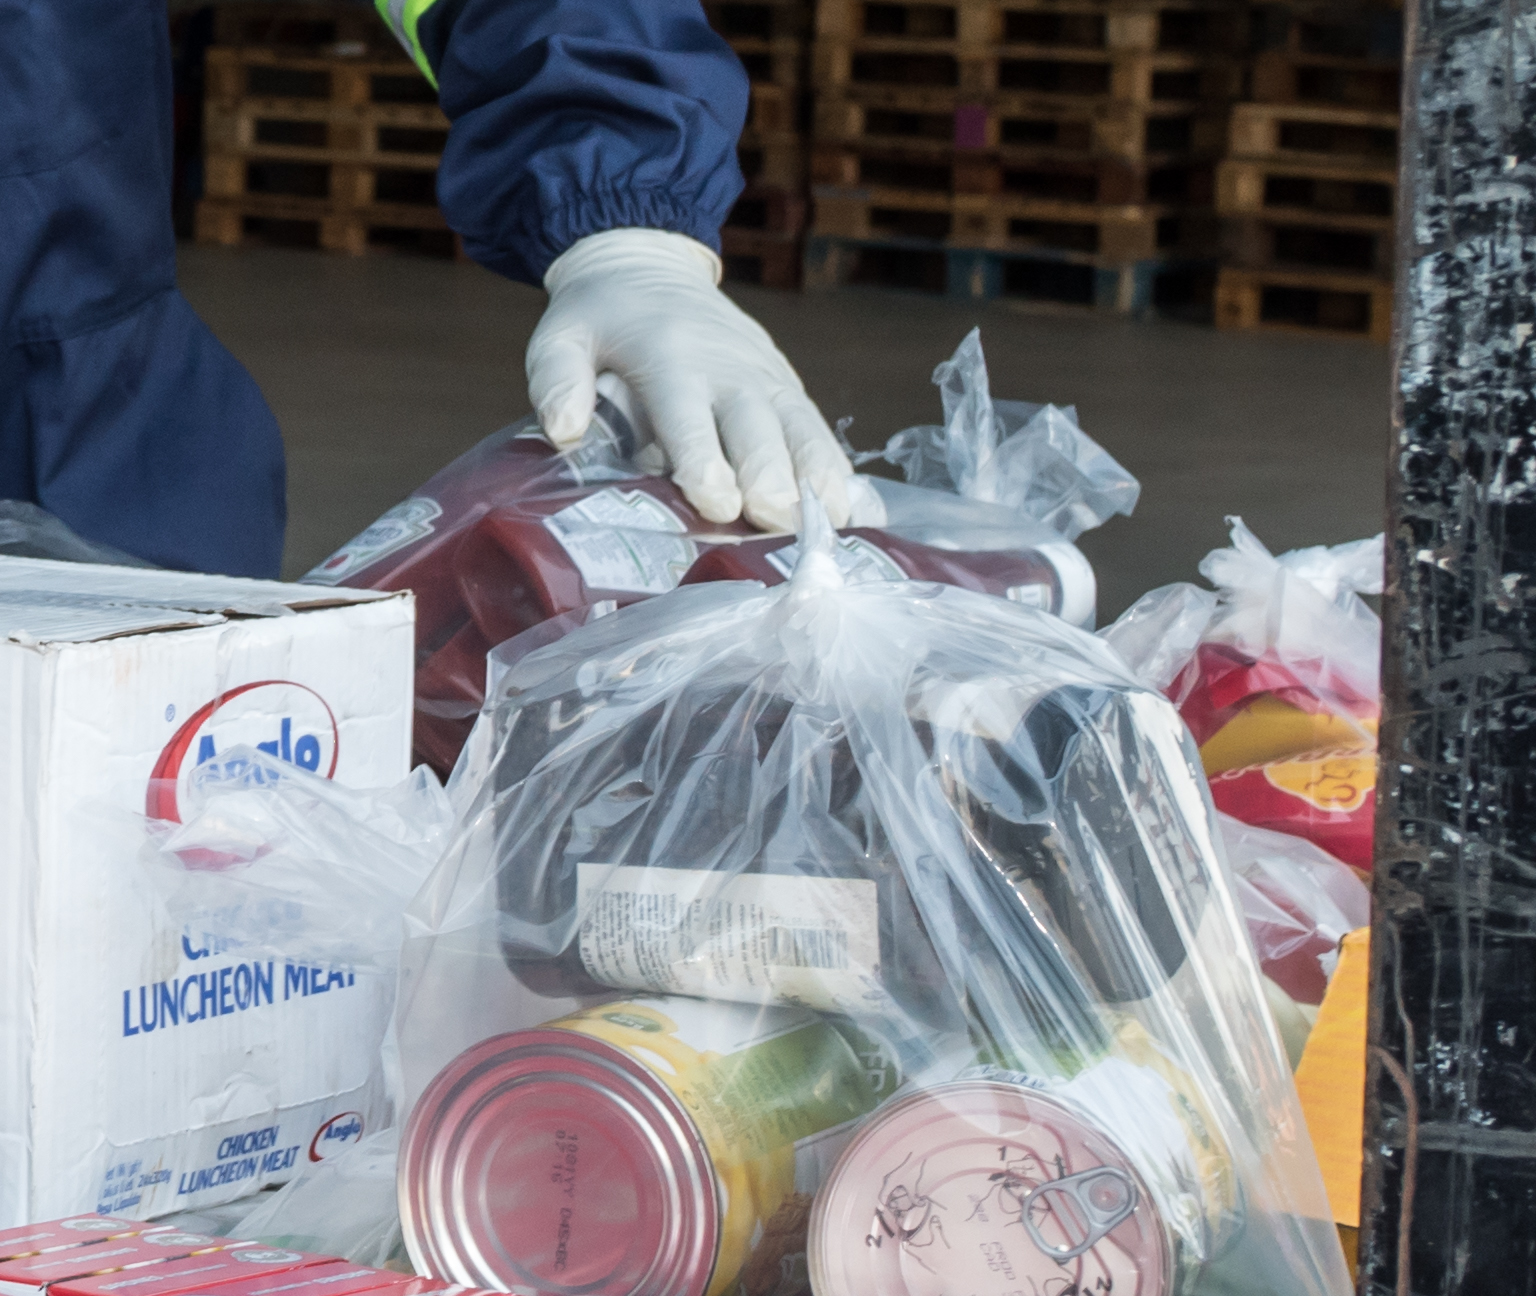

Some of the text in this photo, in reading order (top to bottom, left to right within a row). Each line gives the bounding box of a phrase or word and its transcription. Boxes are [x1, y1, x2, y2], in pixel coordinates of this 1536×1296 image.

[122, 961, 274, 1038] LUNCHEON
[217, 1125, 280, 1161] CHICKEN
[323, 1116, 361, 1142] Anglo
[178, 1157, 259, 1196] LUNCHEON
[260, 1145, 301, 1174] MEAT
